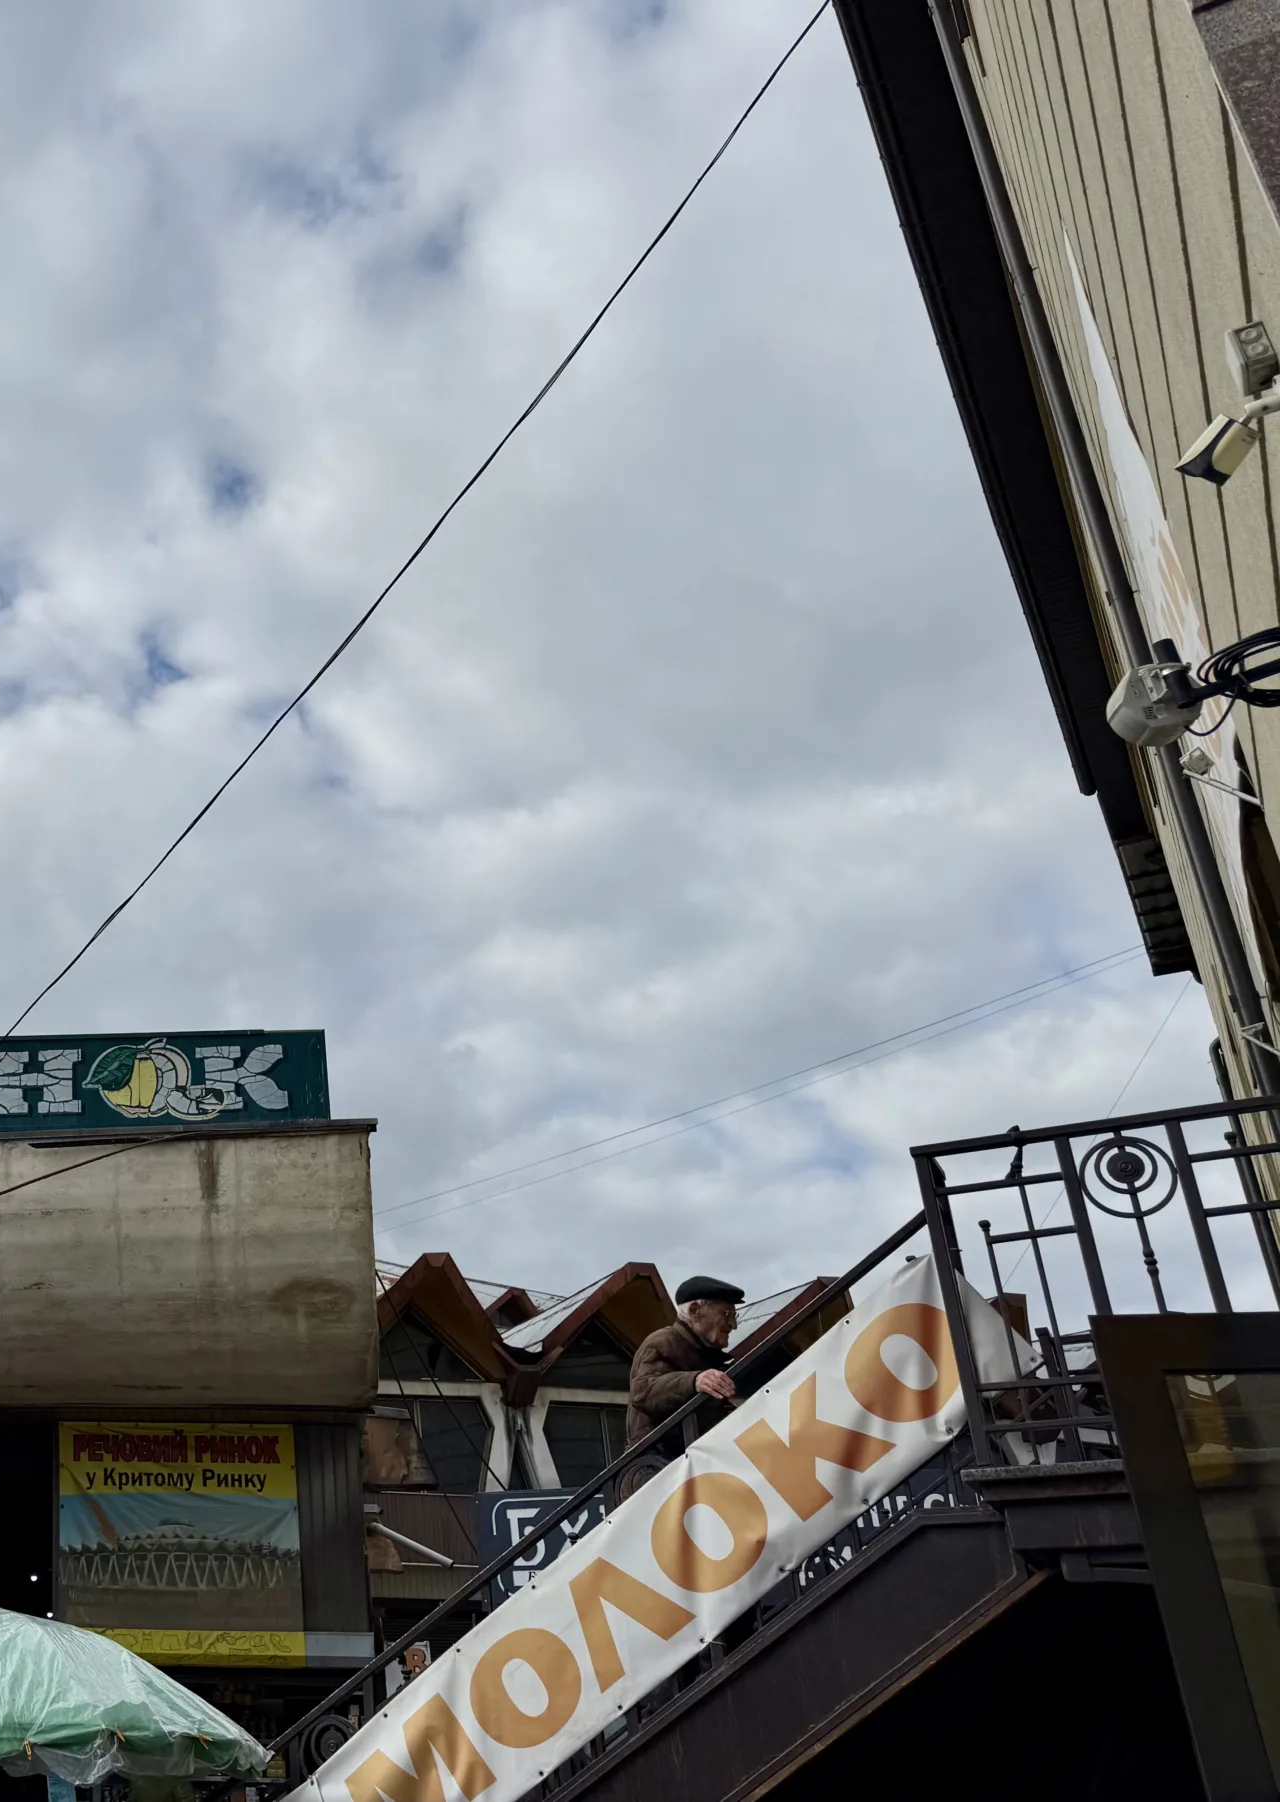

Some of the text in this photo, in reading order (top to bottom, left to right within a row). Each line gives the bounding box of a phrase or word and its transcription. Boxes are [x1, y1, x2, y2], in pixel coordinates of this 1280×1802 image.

[73, 1429, 281, 1464] РЕЧОВИЙ РИНОК
[86, 1467, 268, 1492] у Критому Ринку
[343, 1302, 963, 1802] МОЛОКО
